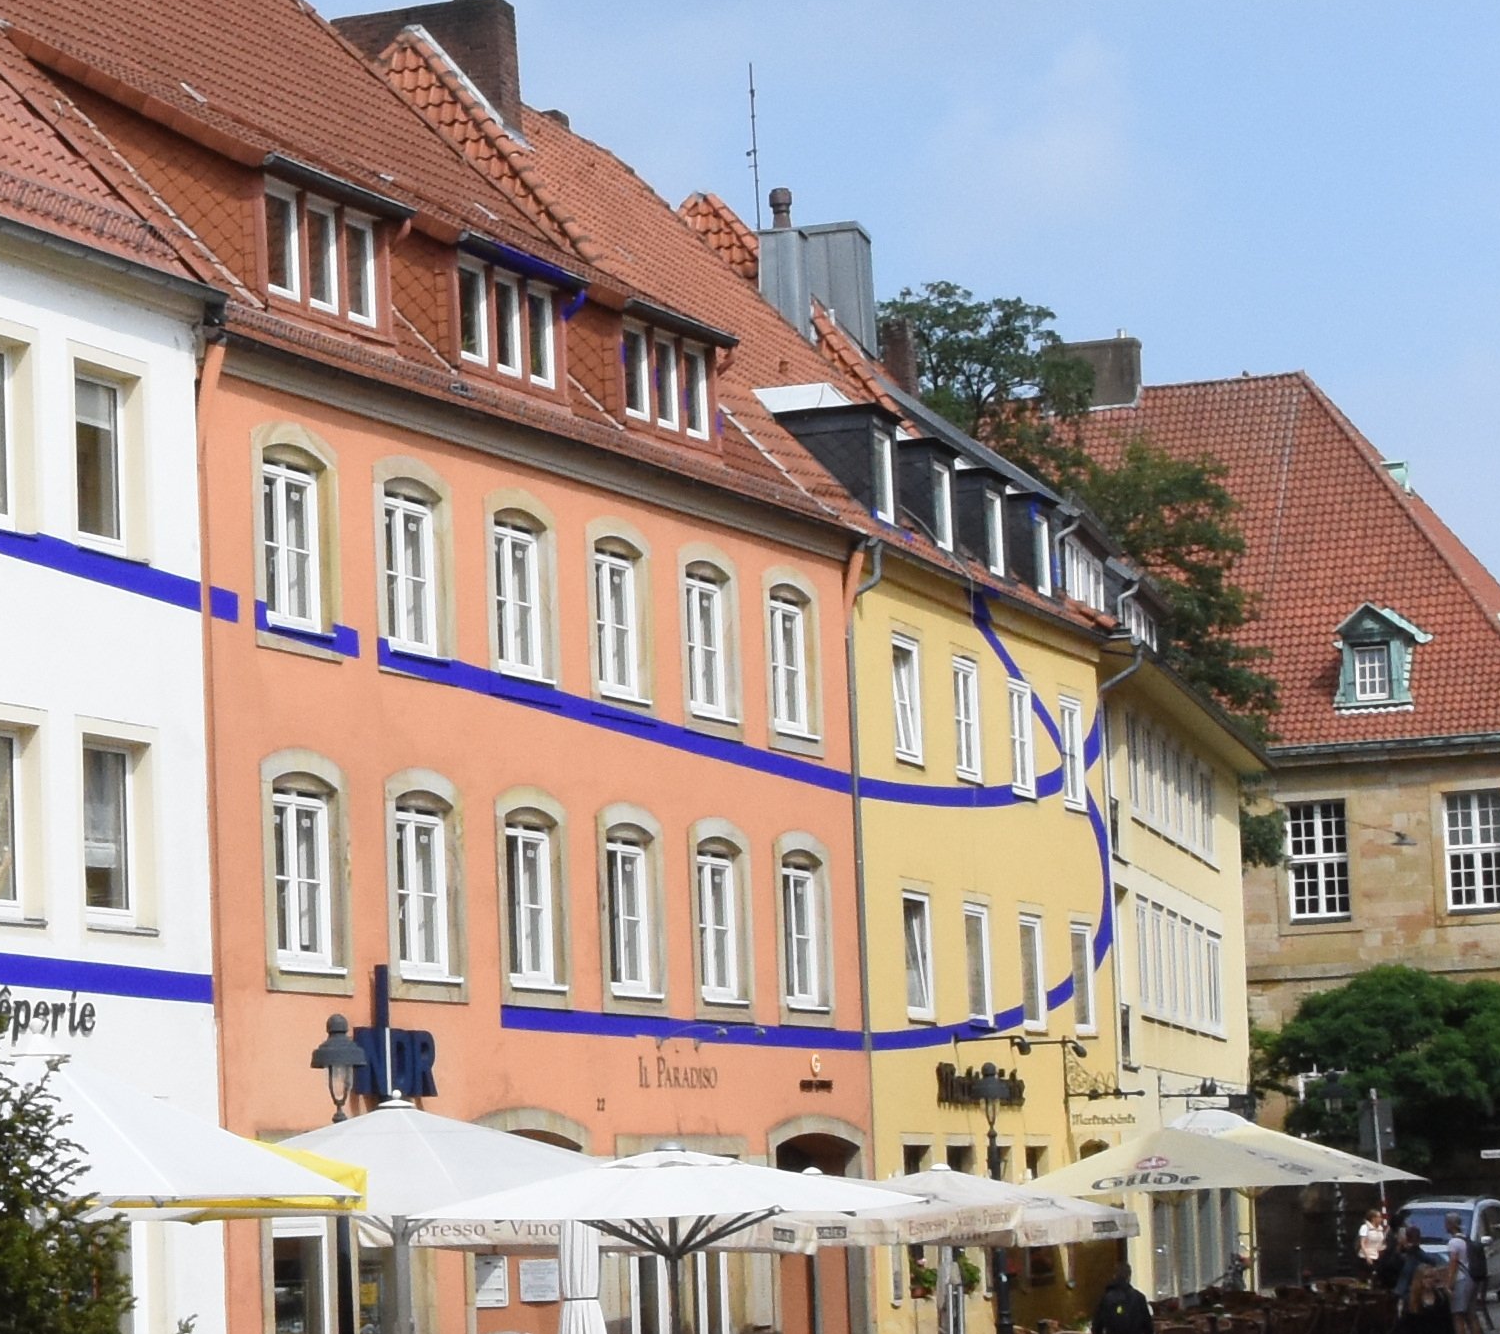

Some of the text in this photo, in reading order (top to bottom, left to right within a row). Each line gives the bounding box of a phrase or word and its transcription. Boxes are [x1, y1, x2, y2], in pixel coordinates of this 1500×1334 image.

[353, 1027, 439, 1097] NDR
[417, 1223, 487, 1244] presso
[510, 1219, 562, 1237] Vino
